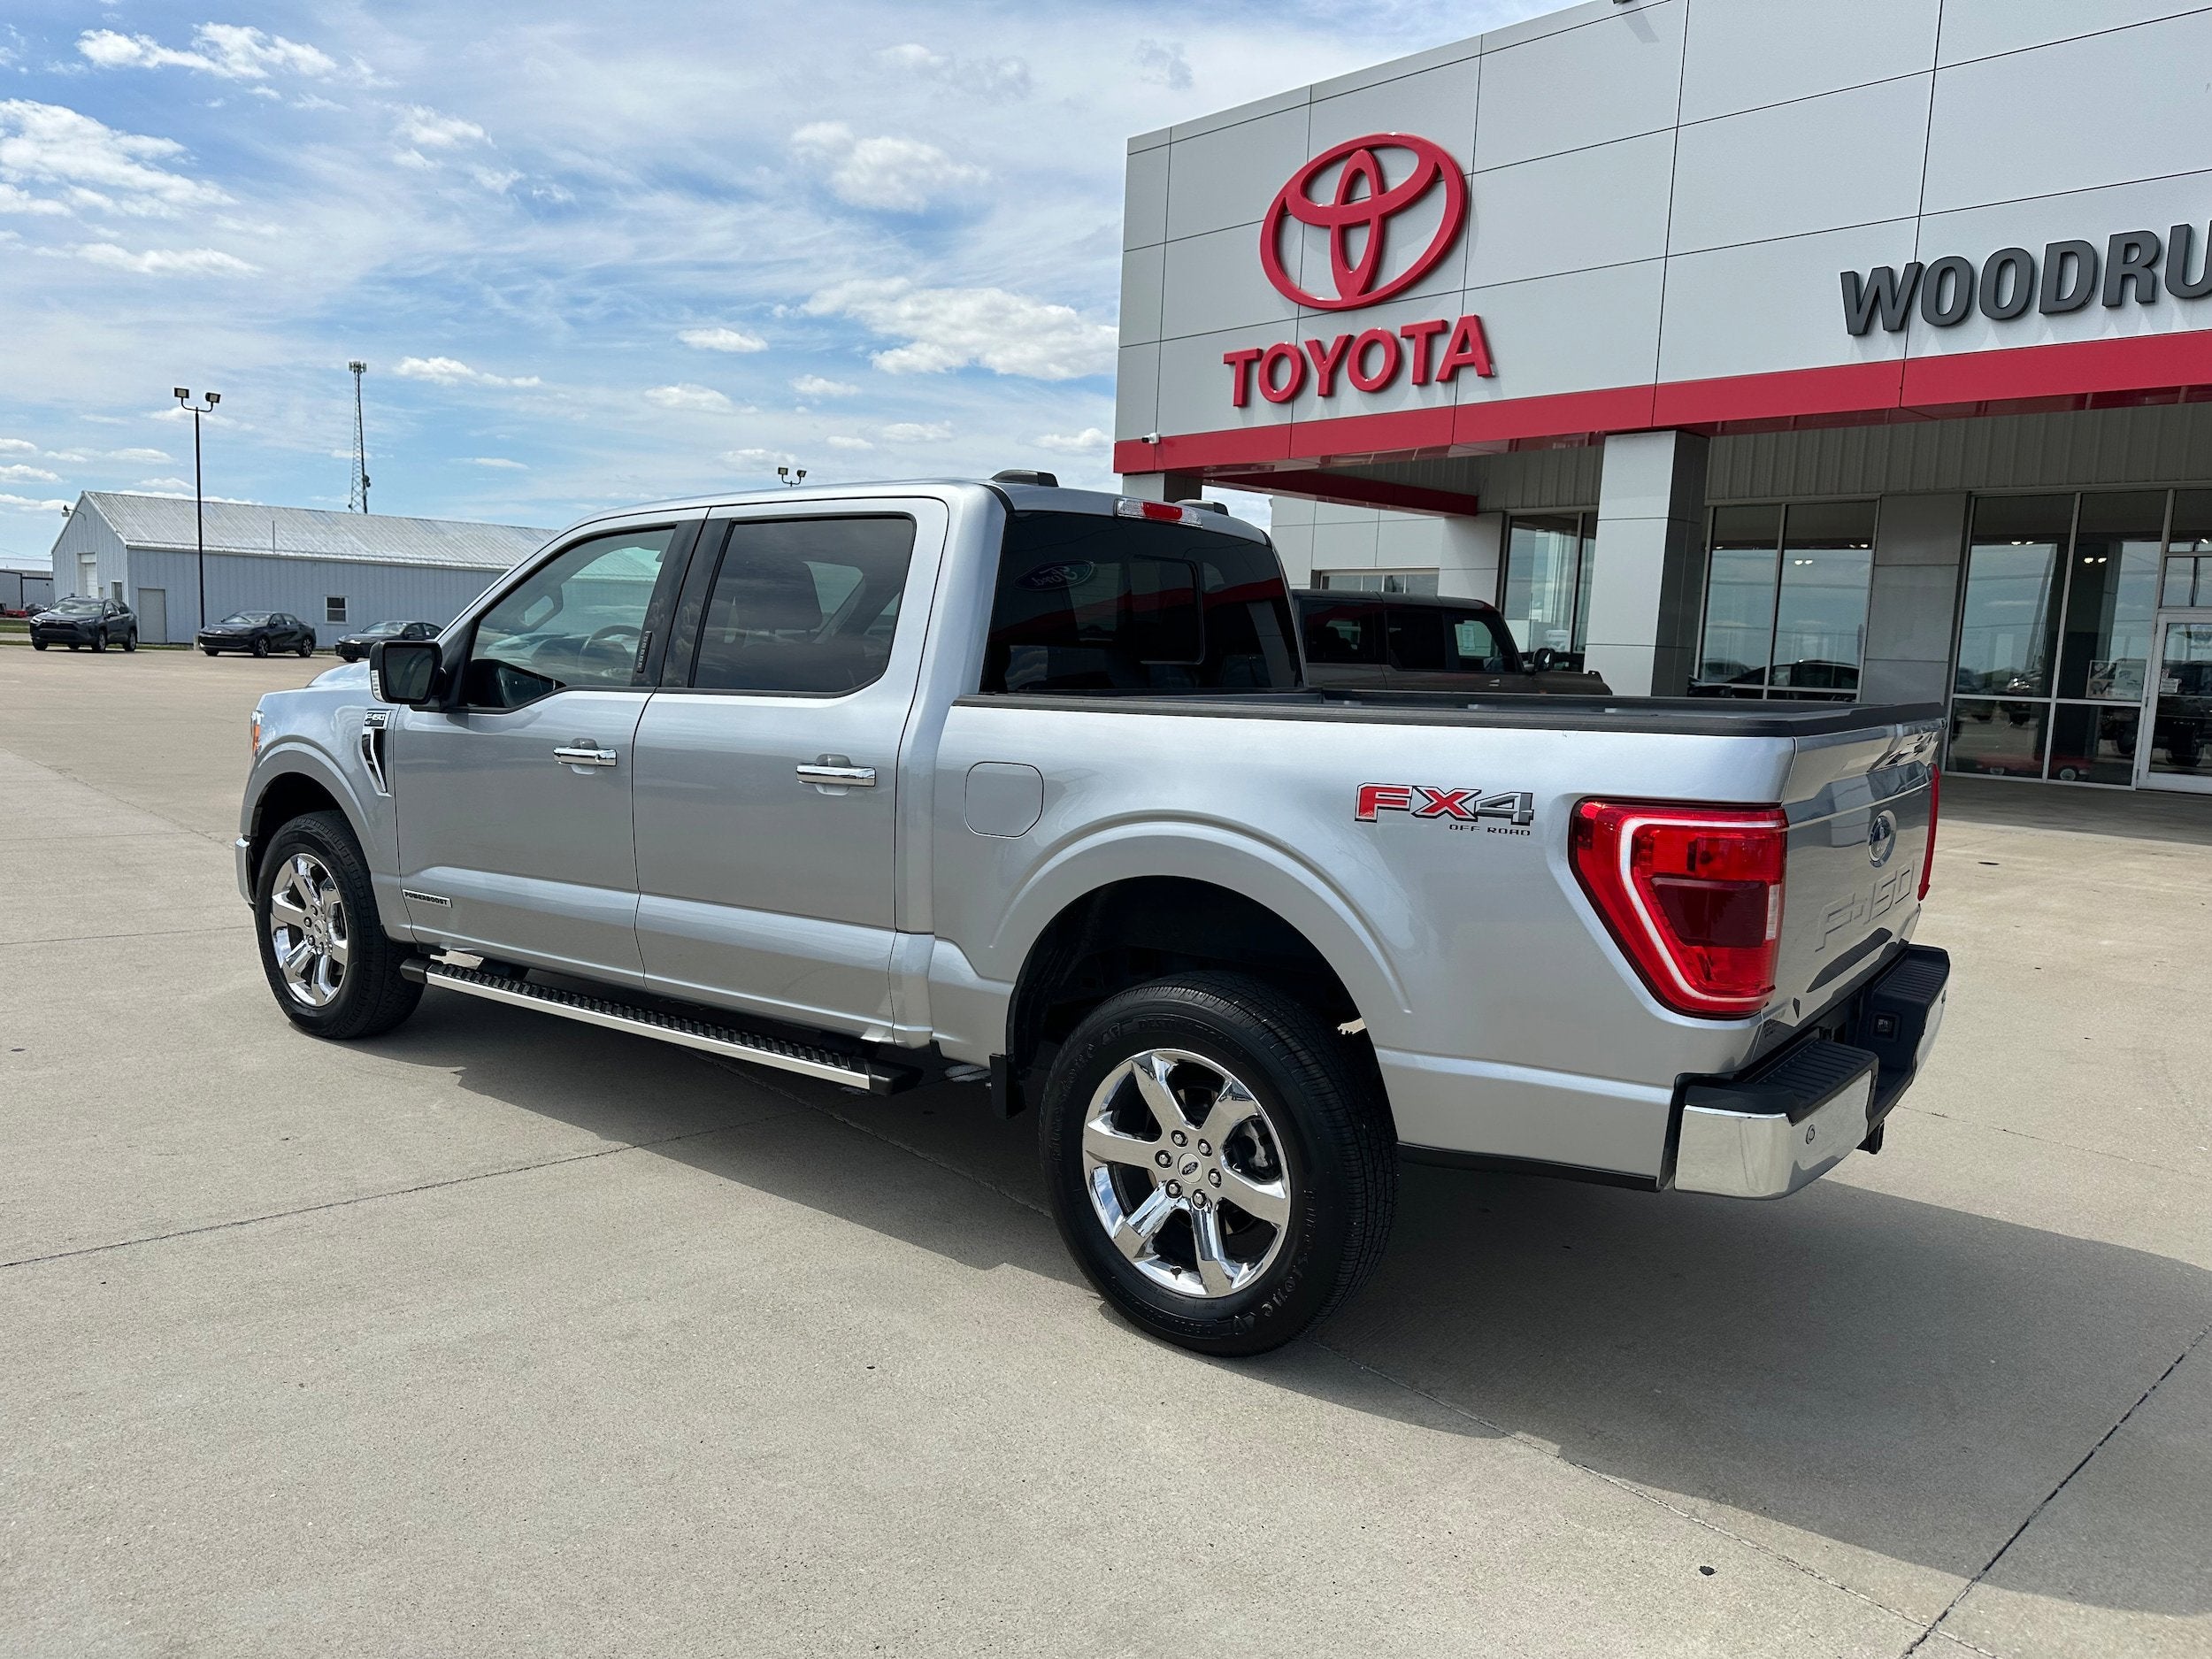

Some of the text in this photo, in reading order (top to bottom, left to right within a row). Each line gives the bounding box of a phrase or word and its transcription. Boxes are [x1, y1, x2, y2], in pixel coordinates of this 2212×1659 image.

[1841, 219, 2212, 335] WOODRU
[1224, 313, 1495, 408] TOYOTA
[1355, 782, 1534, 826] FX4
[1448, 823, 1531, 836] OFF ROAD
[403, 891, 449, 906] POWERBOOST
